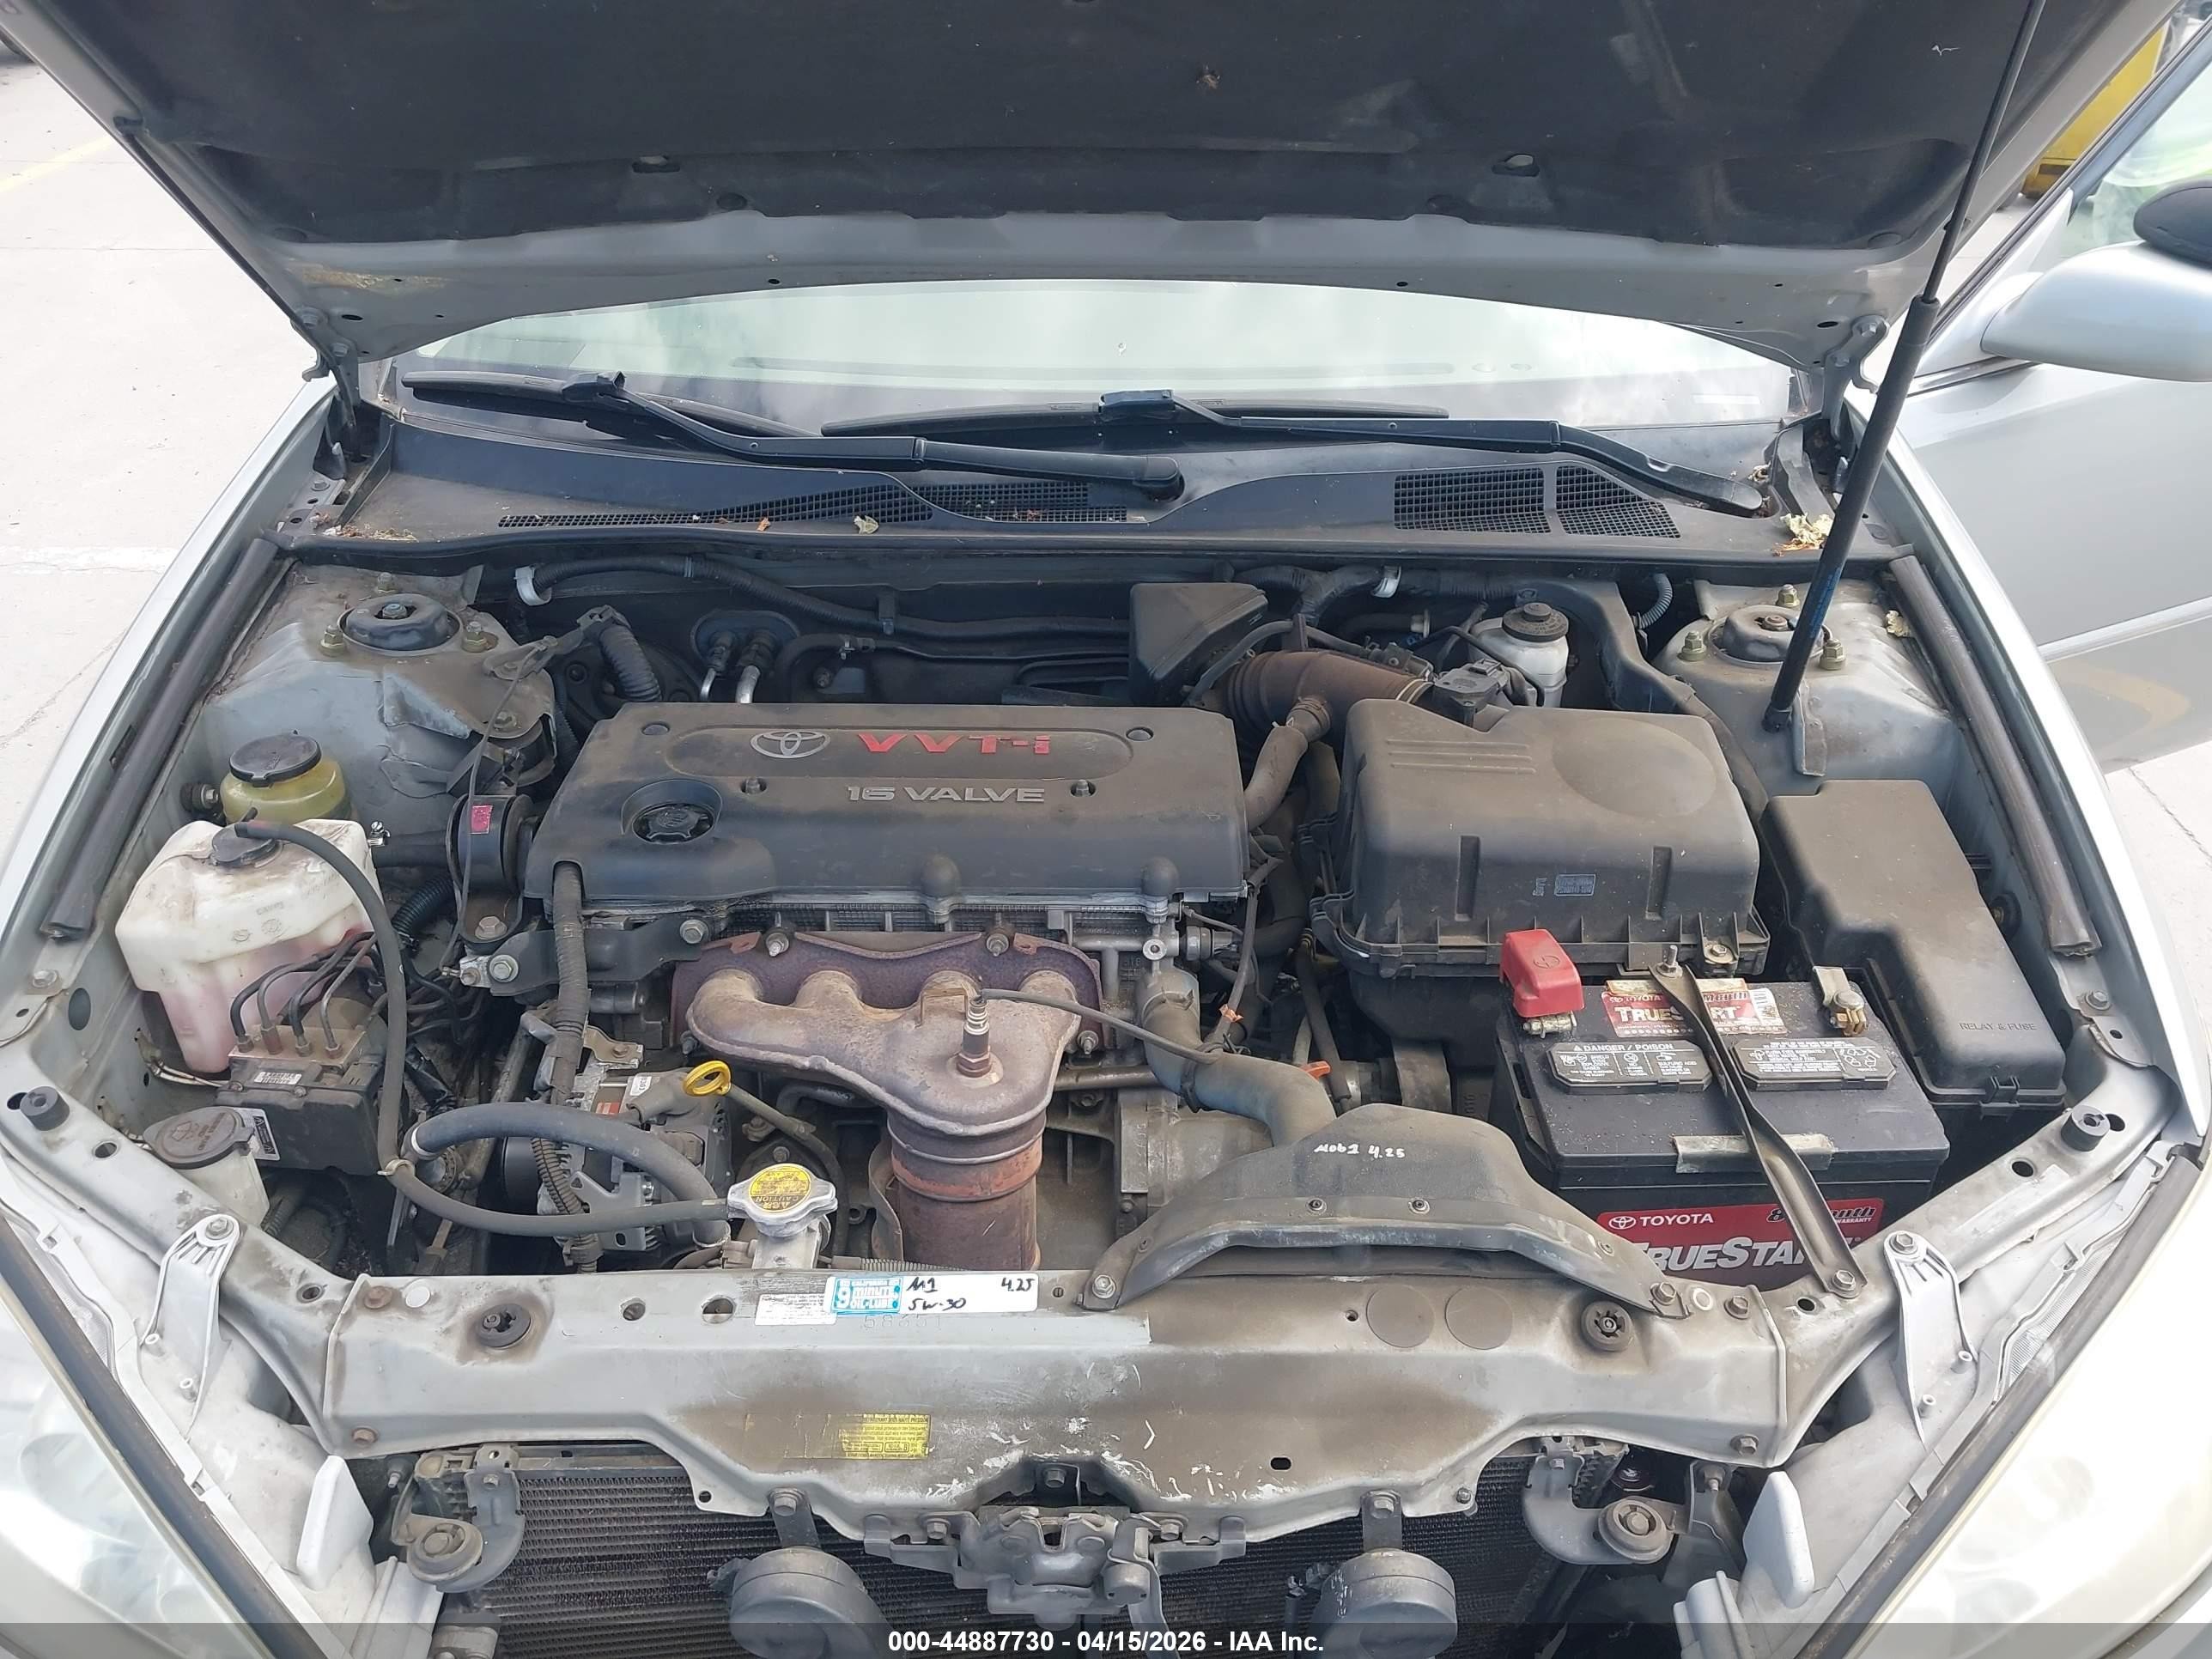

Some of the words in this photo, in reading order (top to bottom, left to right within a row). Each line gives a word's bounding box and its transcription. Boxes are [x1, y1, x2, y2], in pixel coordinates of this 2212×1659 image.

[858, 733, 1052, 755] VVT-i
[847, 787, 896, 801] 16
[903, 787, 1046, 803] VALVE
[1368, 1145, 1406, 1158] 4.25
[1639, 1213, 1714, 1227] TOYOTA
[1000, 1277, 1036, 1291] 4.25
